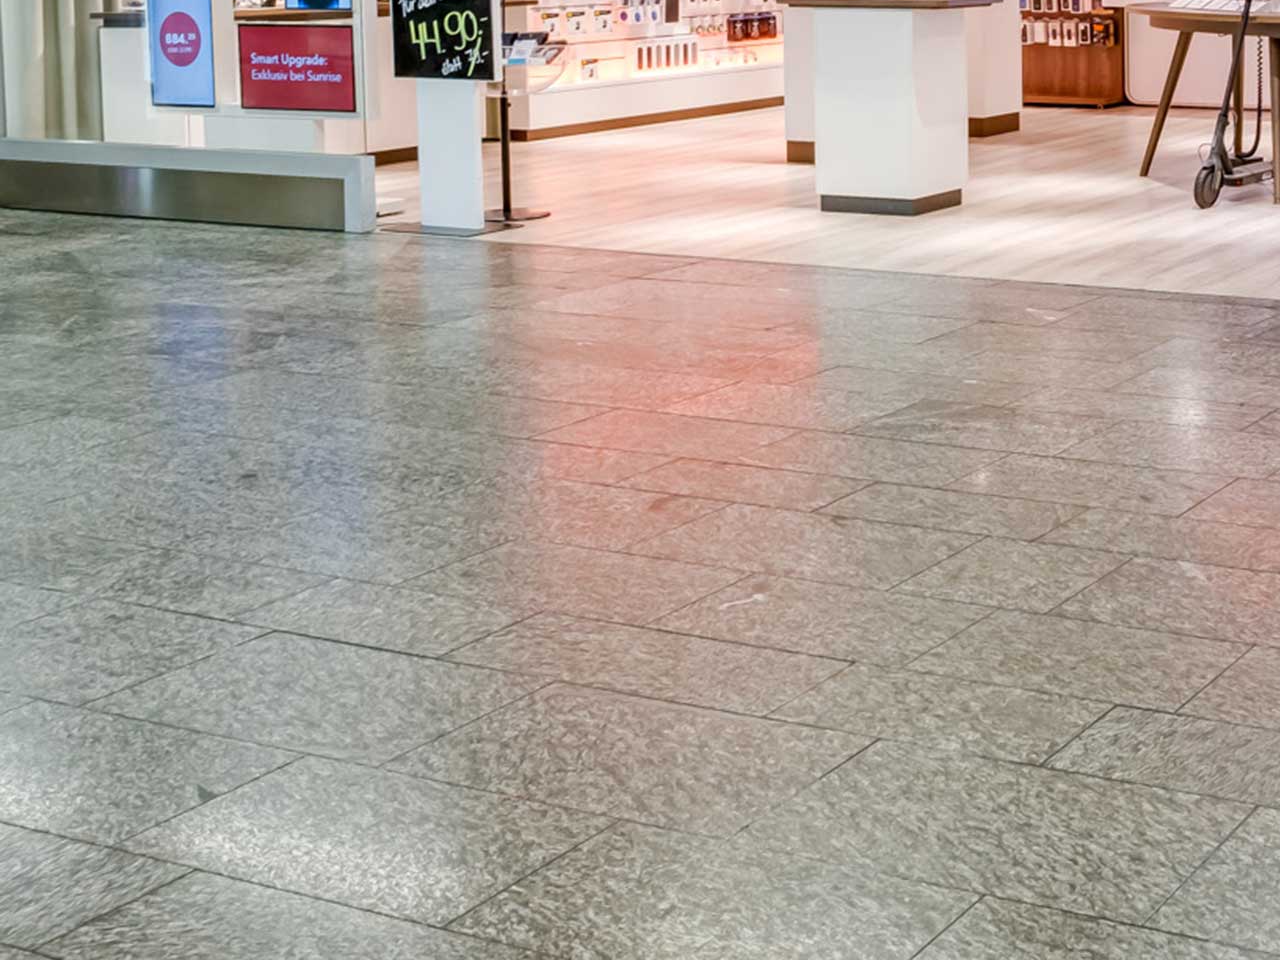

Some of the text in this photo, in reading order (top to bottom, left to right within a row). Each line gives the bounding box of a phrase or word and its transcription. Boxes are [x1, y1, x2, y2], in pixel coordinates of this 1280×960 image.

[250, 52, 328, 68] Smart Upgrade:
[251, 69, 342, 83] Exklusiv bei Sunrise
